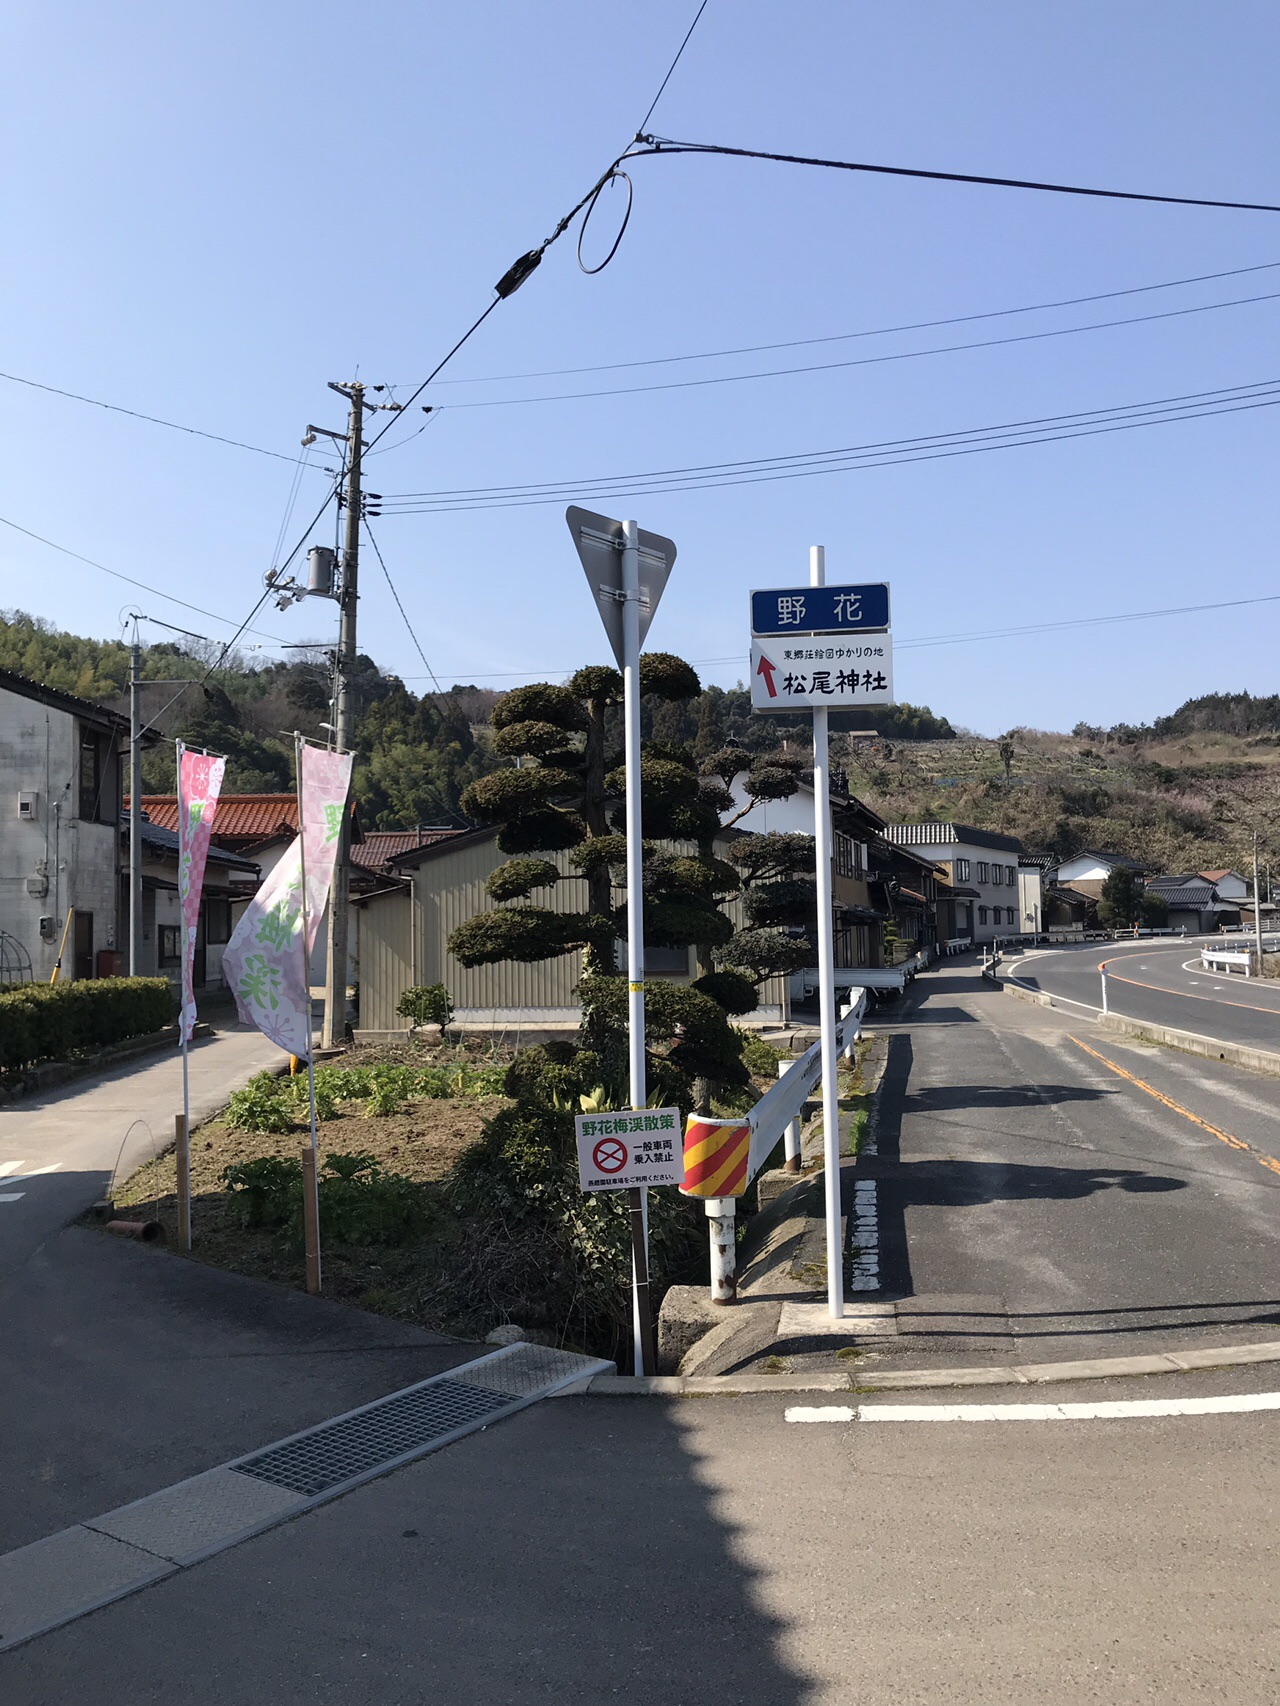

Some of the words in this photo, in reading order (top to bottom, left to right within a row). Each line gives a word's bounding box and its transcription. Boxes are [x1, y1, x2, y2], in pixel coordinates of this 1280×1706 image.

[778, 592, 863, 625] 野花
[783, 647, 884, 661] 東郷荘絵図ゆかりの地
[782, 669, 888, 696] 松尾神社
[582, 1114, 675, 1137] 野花梅渓散策
[633, 1139, 673, 1152] 一般車両
[634, 1152, 674, 1165] 乗入禁止
